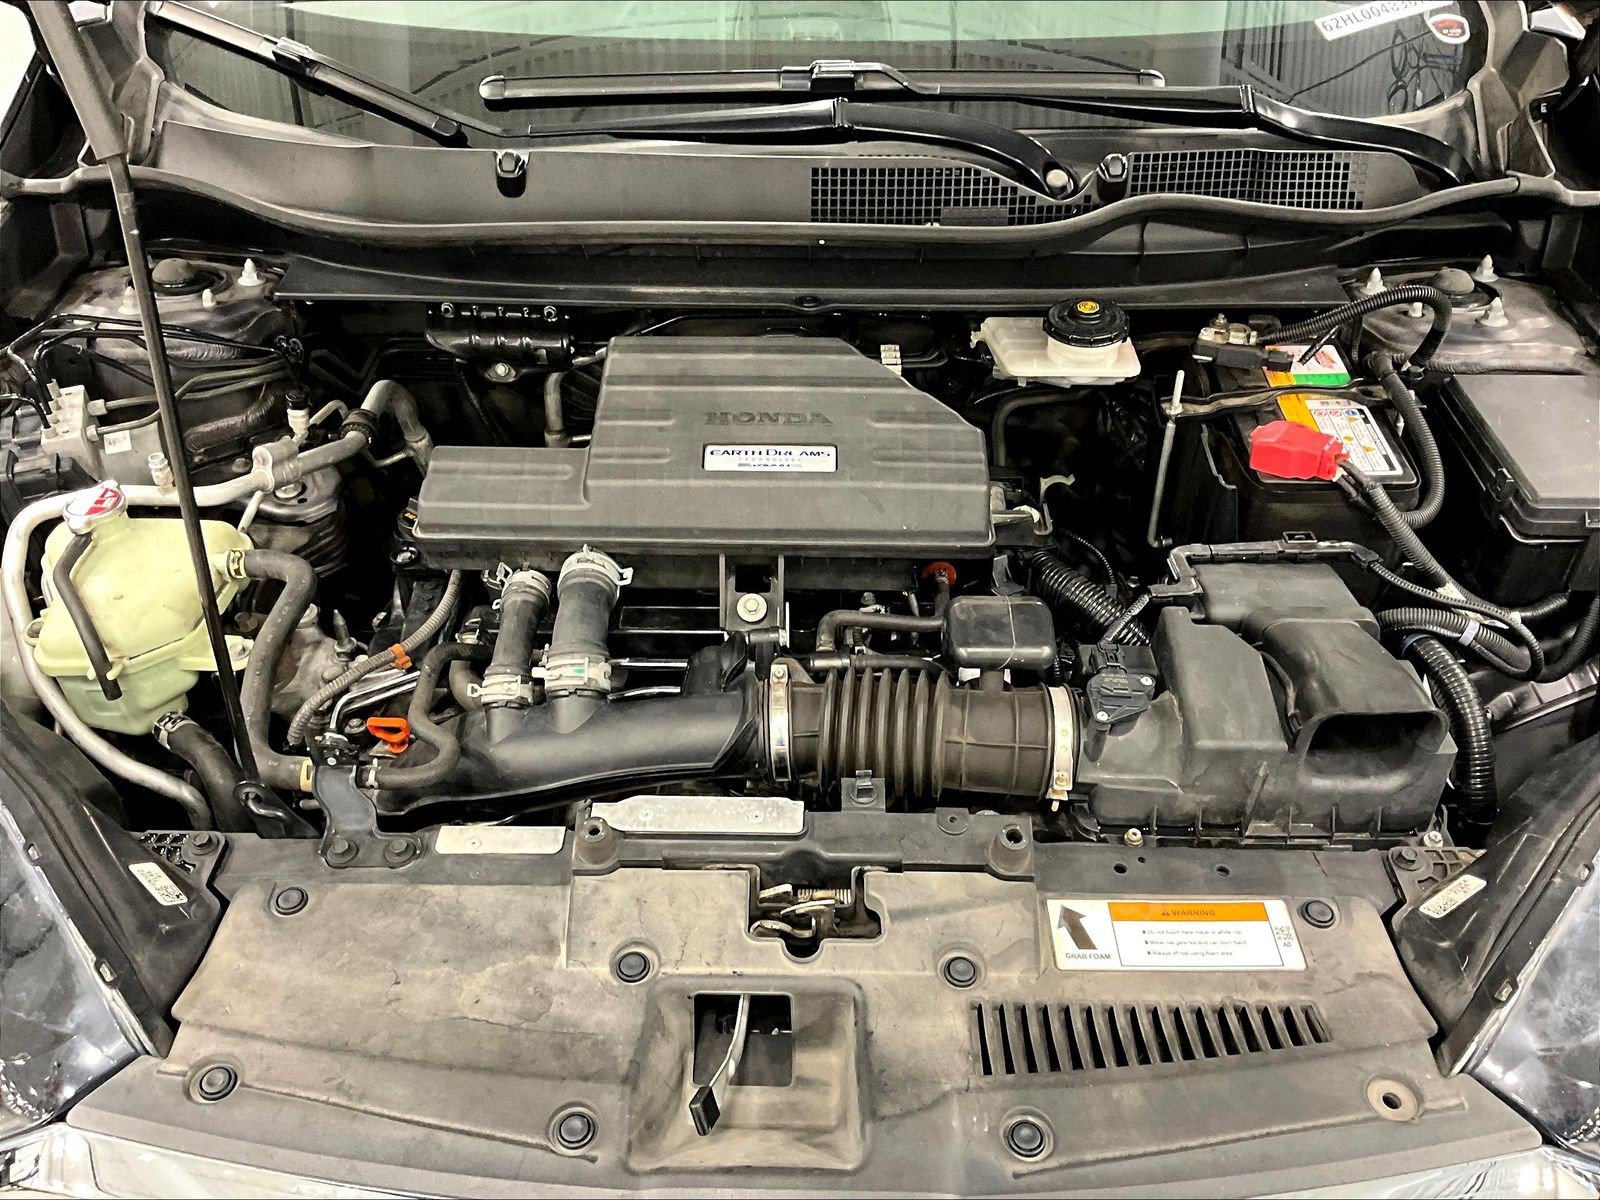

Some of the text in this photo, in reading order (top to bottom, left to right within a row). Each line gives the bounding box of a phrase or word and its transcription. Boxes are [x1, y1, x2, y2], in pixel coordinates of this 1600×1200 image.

[704, 411, 834, 426] HONDA
[1172, 909, 1216, 917] WARNING
[1065, 952, 1112, 960] GRAB FOAM
